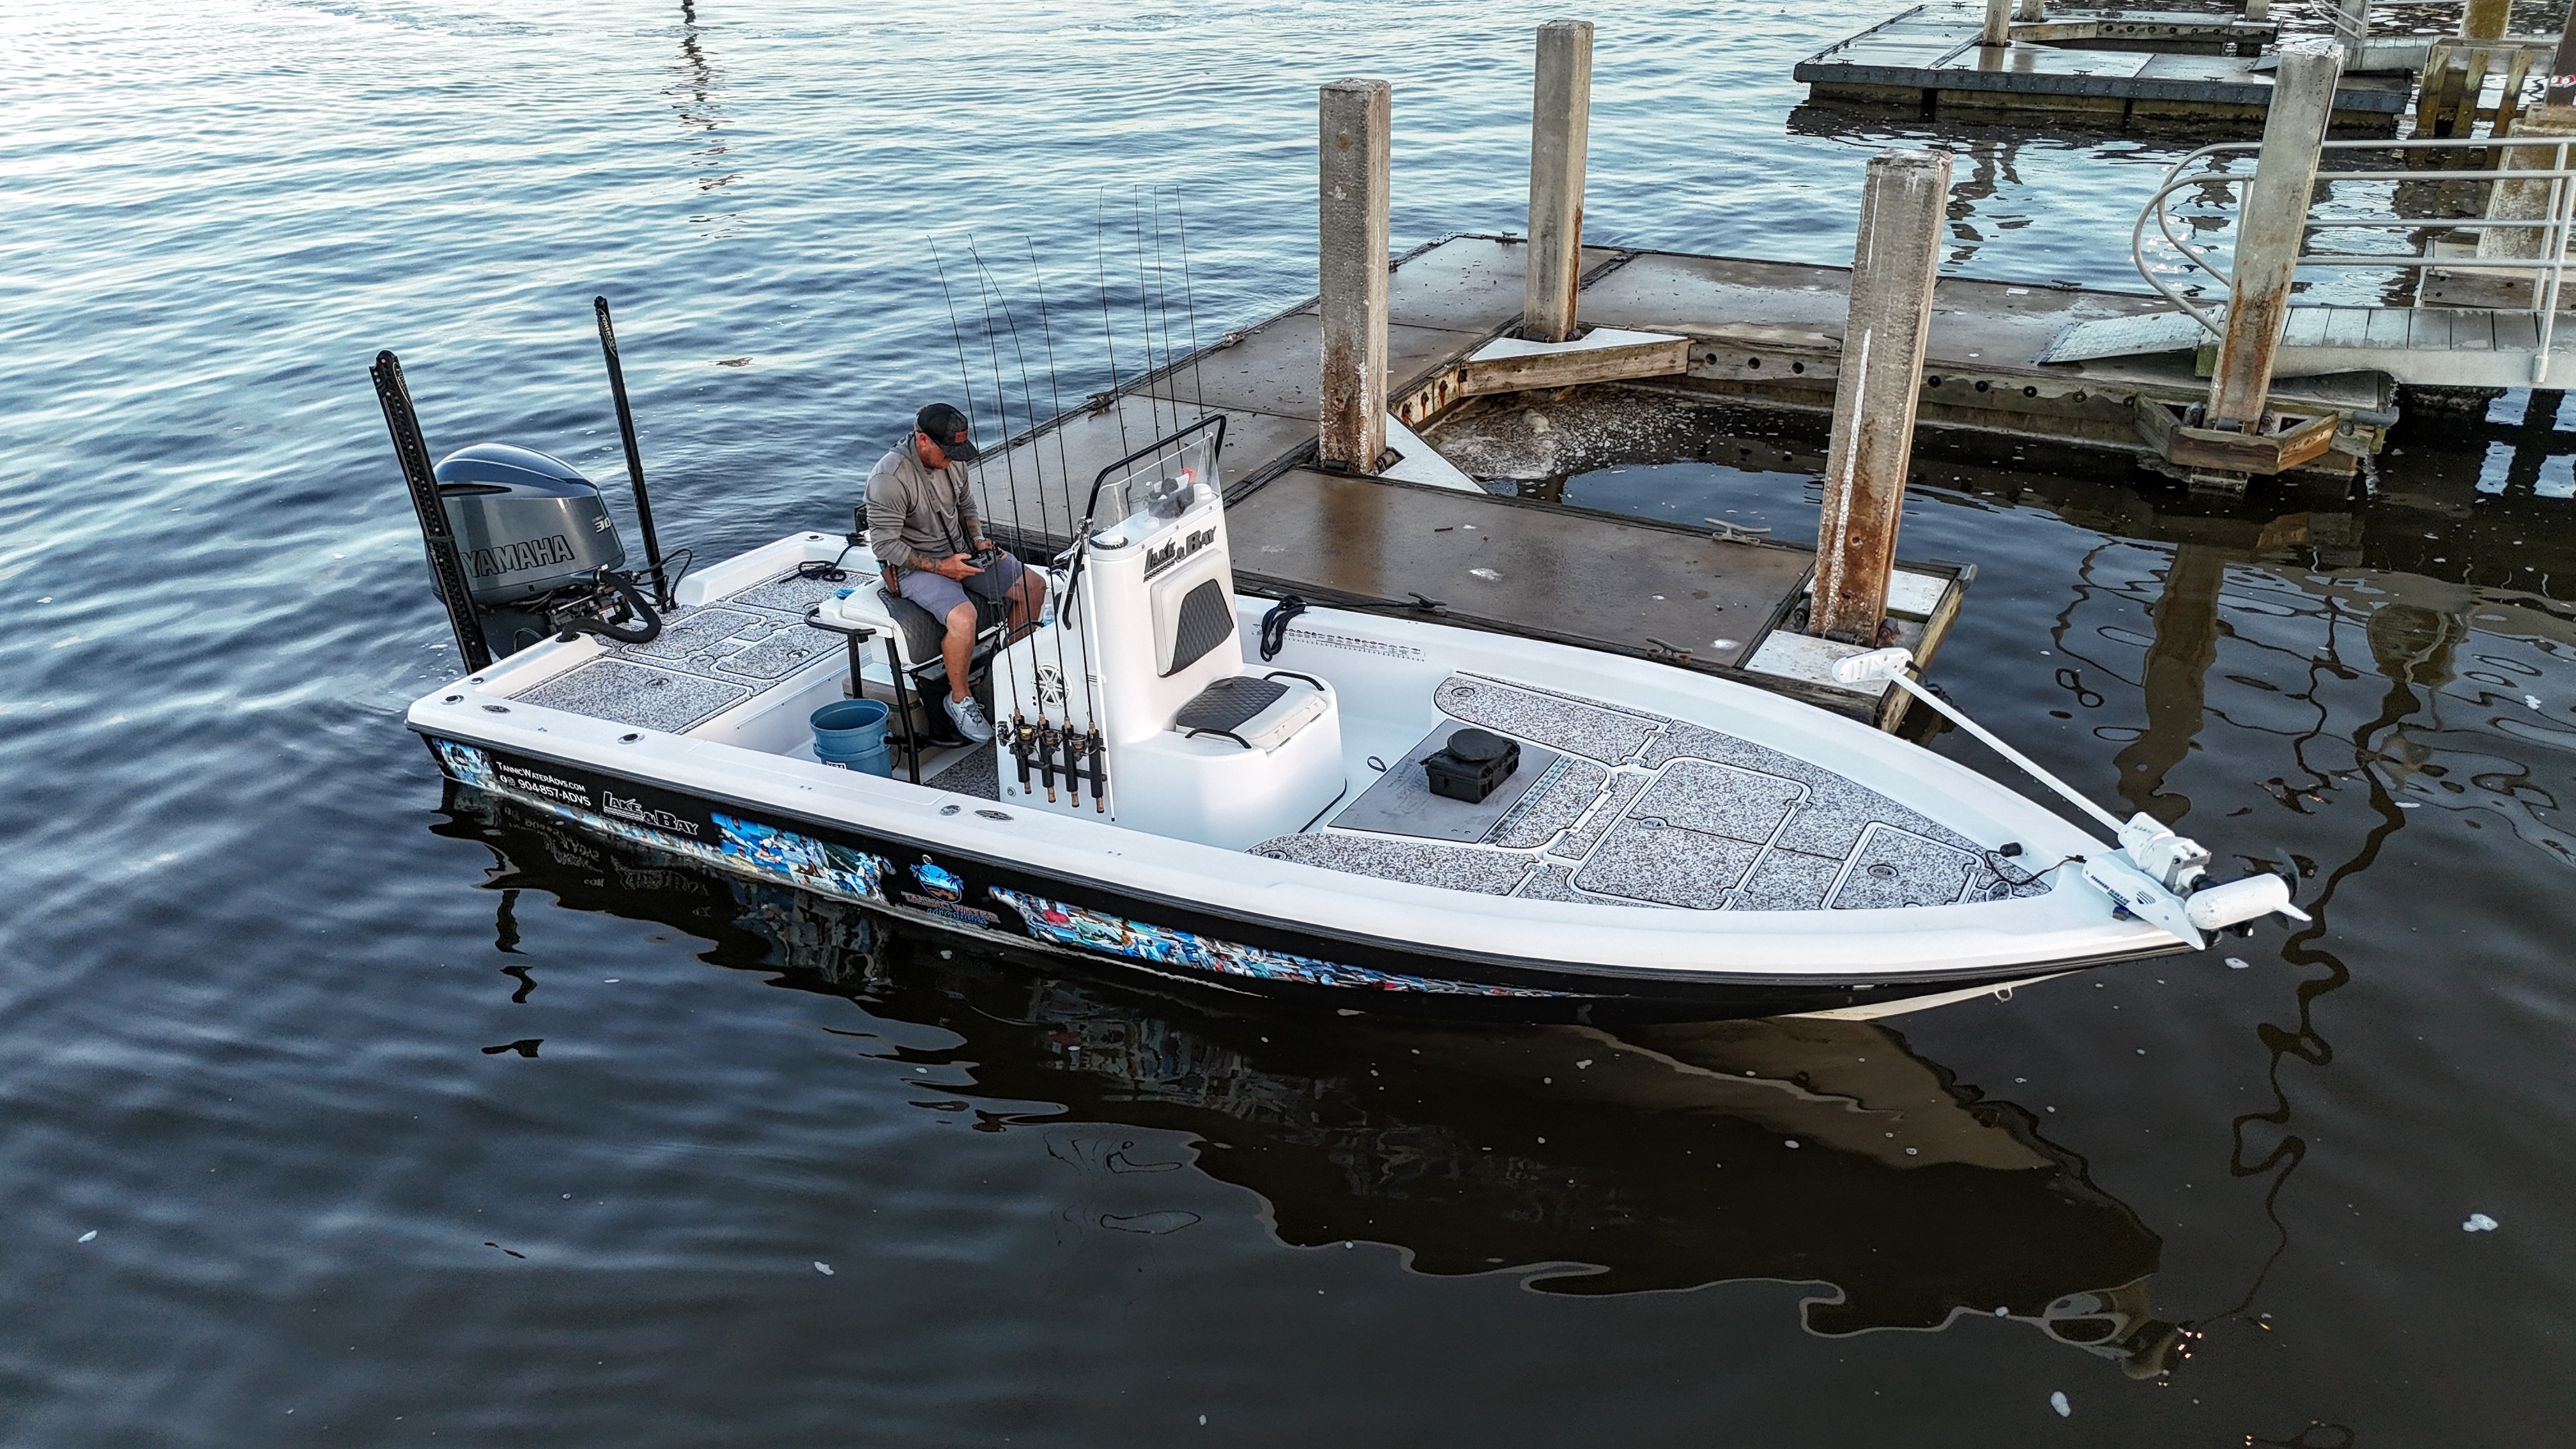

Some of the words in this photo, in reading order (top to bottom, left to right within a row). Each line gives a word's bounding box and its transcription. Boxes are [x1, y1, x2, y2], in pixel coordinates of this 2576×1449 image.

[461, 534, 575, 578] YAMAHA
[1144, 537, 1176, 575] LAKE
[1175, 546, 1186, 564] &
[1186, 525, 1217, 557] BAY
[602, 790, 643, 815] LAKE
[643, 811, 658, 826] &
[655, 809, 699, 836] BAY
